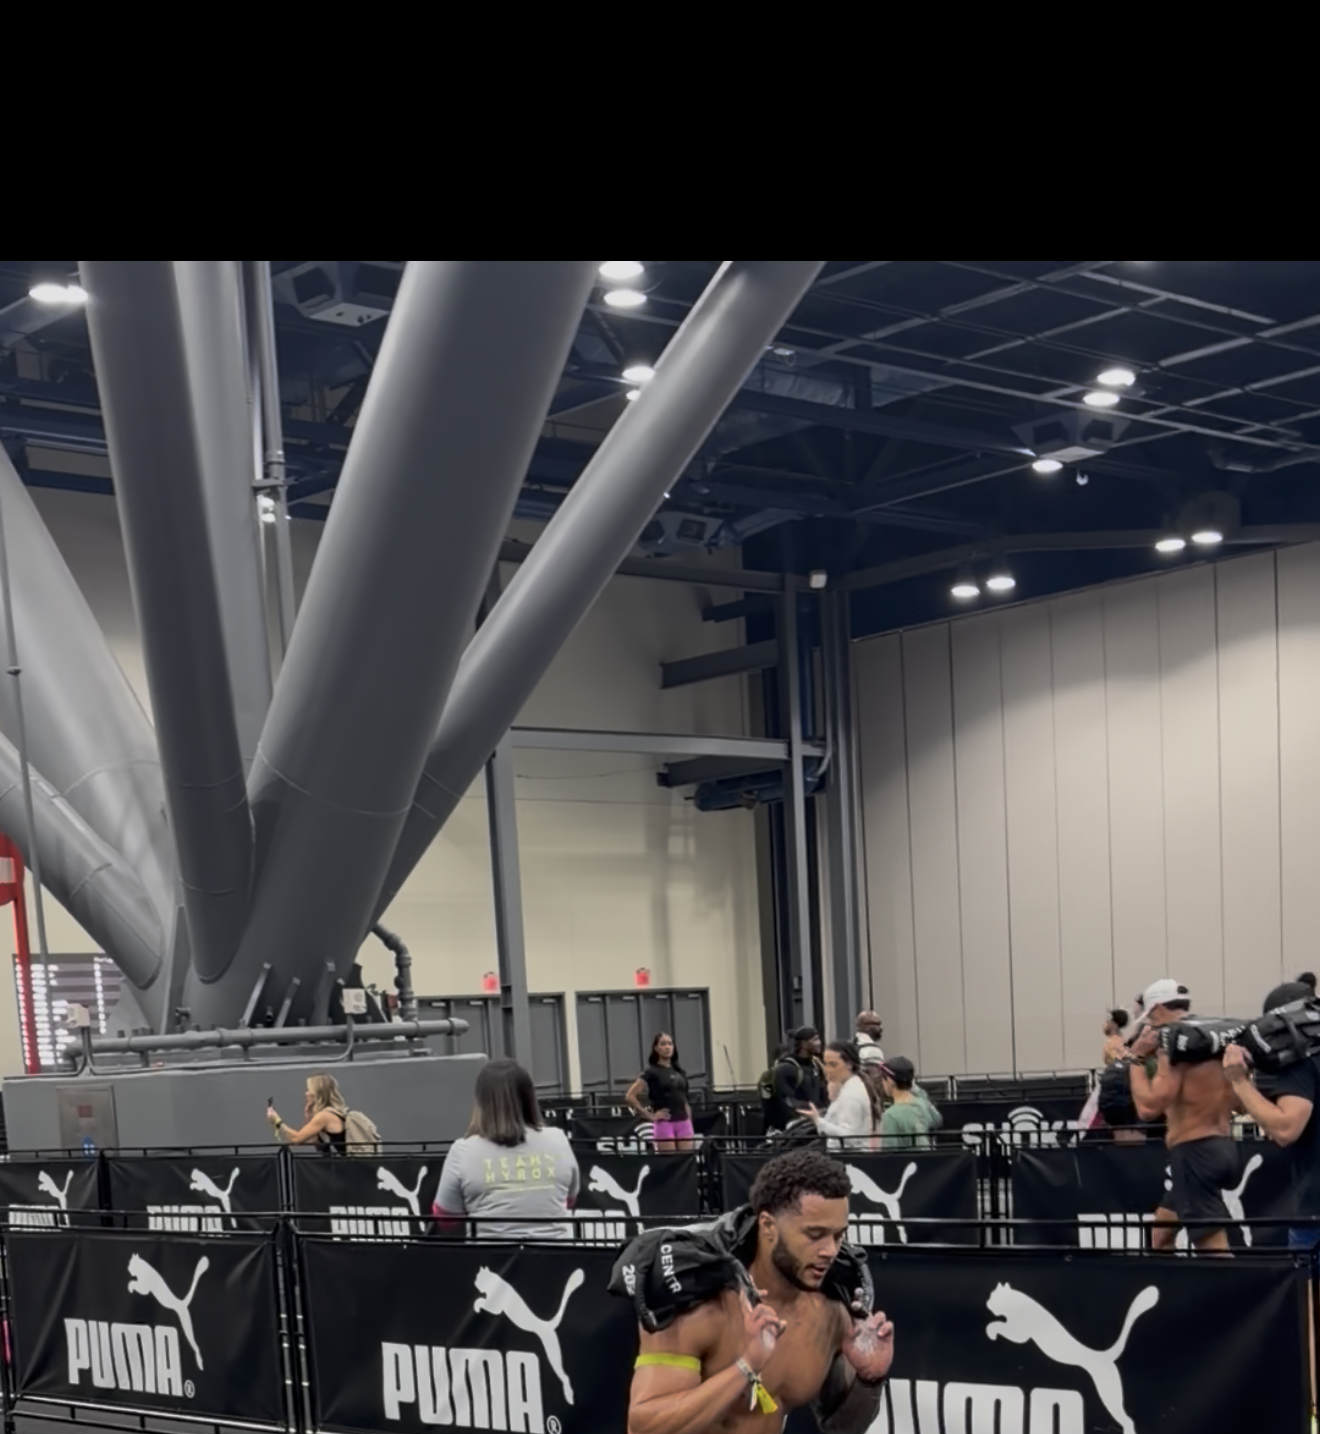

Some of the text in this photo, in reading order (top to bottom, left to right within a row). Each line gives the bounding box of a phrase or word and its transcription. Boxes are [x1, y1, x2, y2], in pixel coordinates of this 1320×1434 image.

[484, 1154, 541, 1170] TEAM
[485, 1167, 556, 1183] HYROX
[660, 1244, 682, 1294] CENTR
